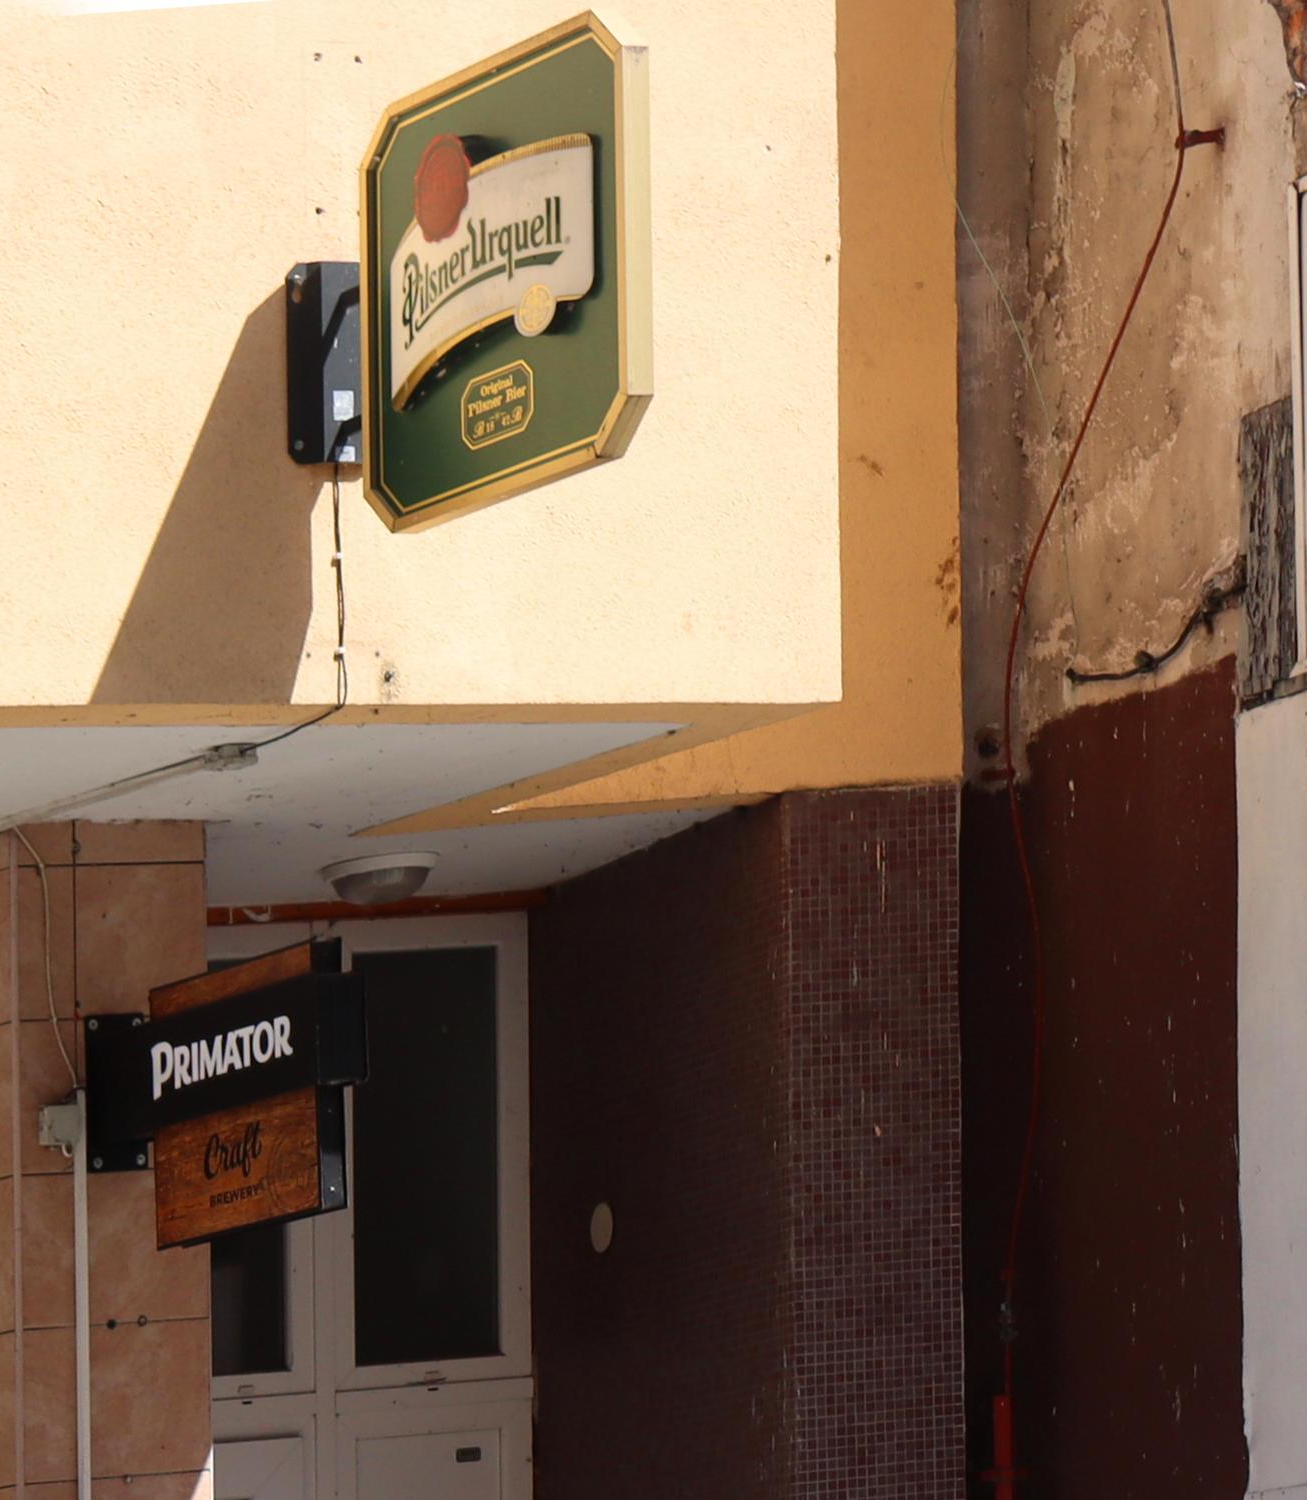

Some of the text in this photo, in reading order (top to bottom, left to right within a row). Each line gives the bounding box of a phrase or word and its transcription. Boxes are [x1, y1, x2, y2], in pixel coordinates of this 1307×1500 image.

[402, 196, 562, 350] Pilsner Urquell
[150, 1015, 293, 1100] PRIMATOR
[203, 1120, 262, 1180] Craft
[209, 1184, 261, 1207] BREWERY
